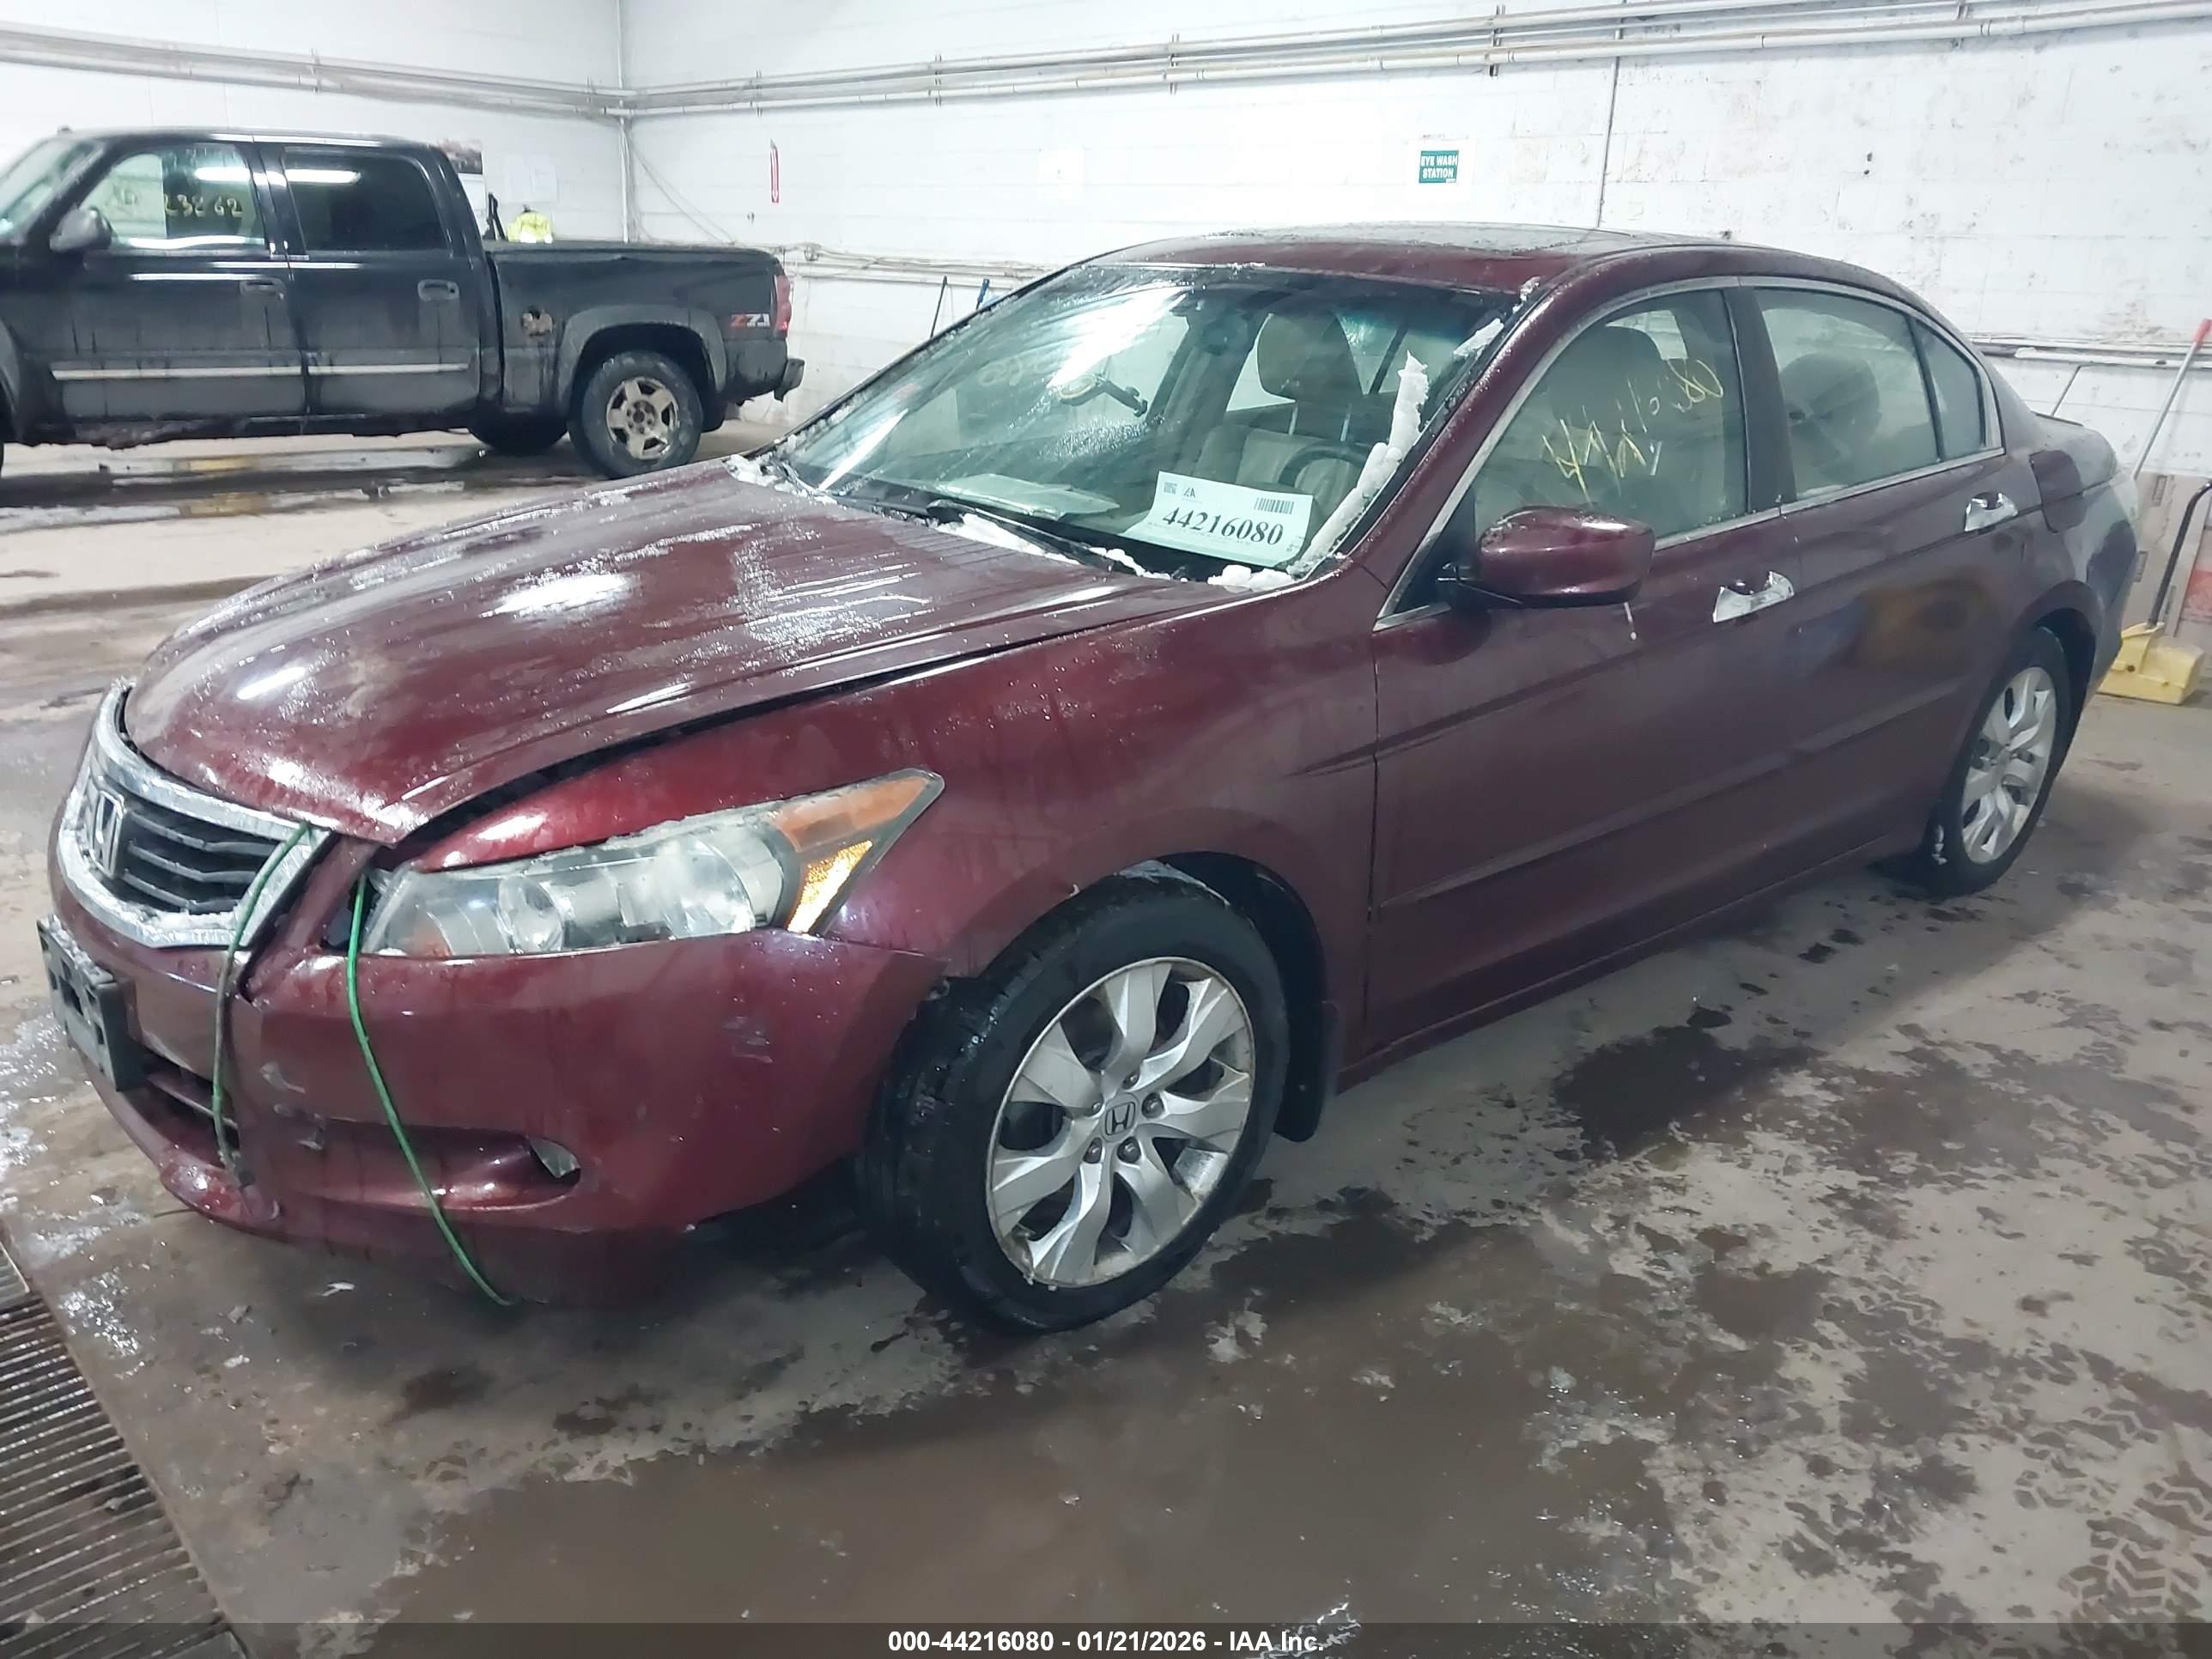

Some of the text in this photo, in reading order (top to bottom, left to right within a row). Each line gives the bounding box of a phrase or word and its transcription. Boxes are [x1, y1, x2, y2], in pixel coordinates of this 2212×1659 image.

[1421, 155, 1458, 166] EYE WASH
[1422, 167, 1454, 179] STATION
[729, 313, 770, 328] Z71
[1162, 507, 1285, 546] 44216080
